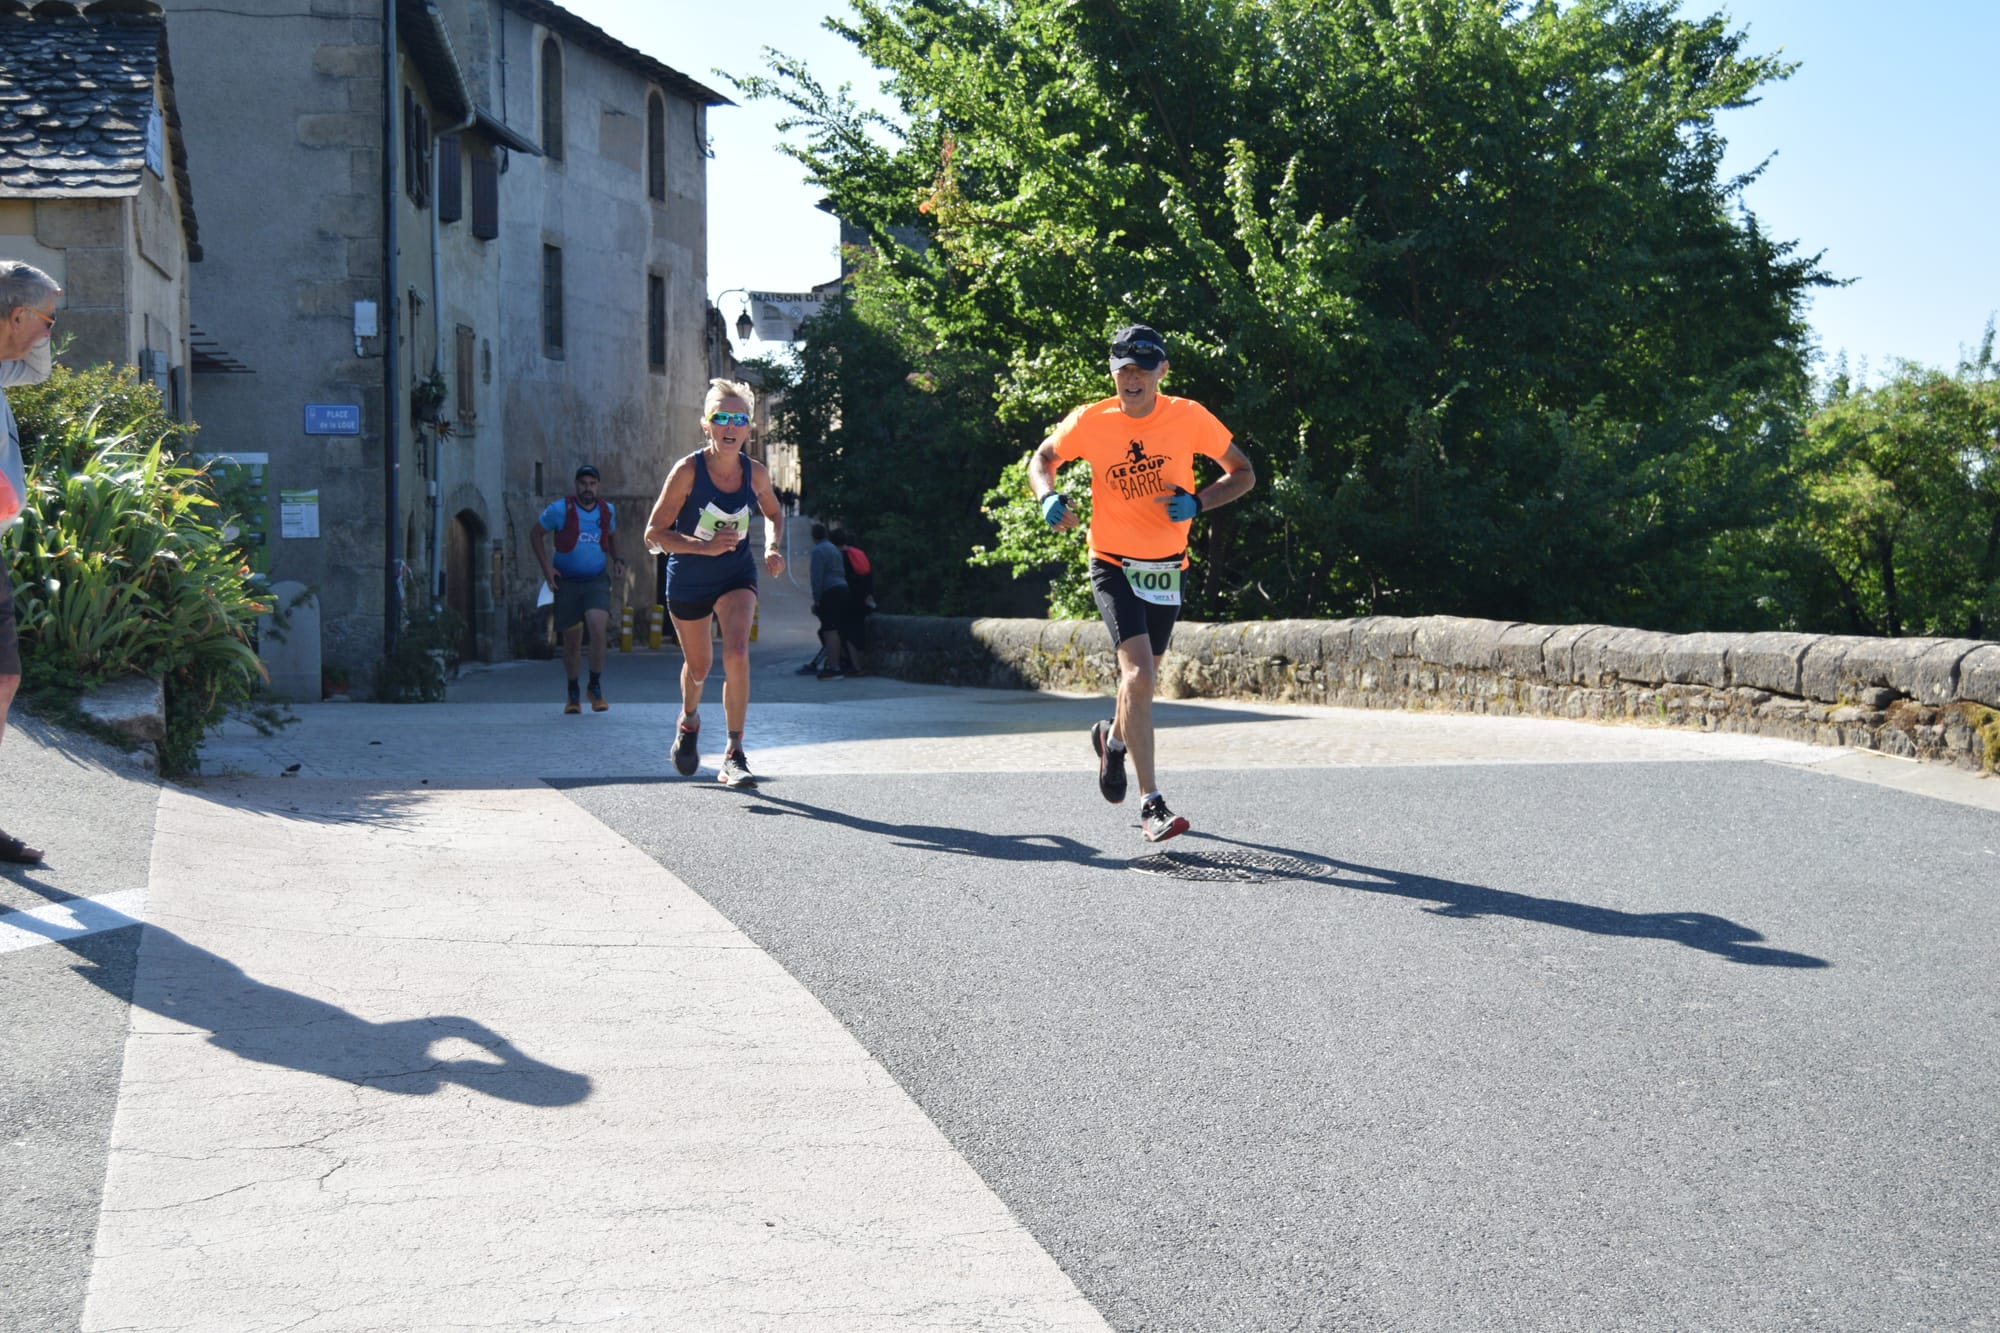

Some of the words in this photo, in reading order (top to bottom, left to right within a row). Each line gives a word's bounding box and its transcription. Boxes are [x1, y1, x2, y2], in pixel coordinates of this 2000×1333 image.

[753, 293, 802, 303] MAISON
[806, 294, 820, 302] DE
[327, 410, 348, 418] PLACE
[1112, 468, 1127, 478] LE
[1129, 458, 1165, 474] COUP
[1119, 470, 1166, 500] BARRE
[1131, 571, 1171, 590] 100
